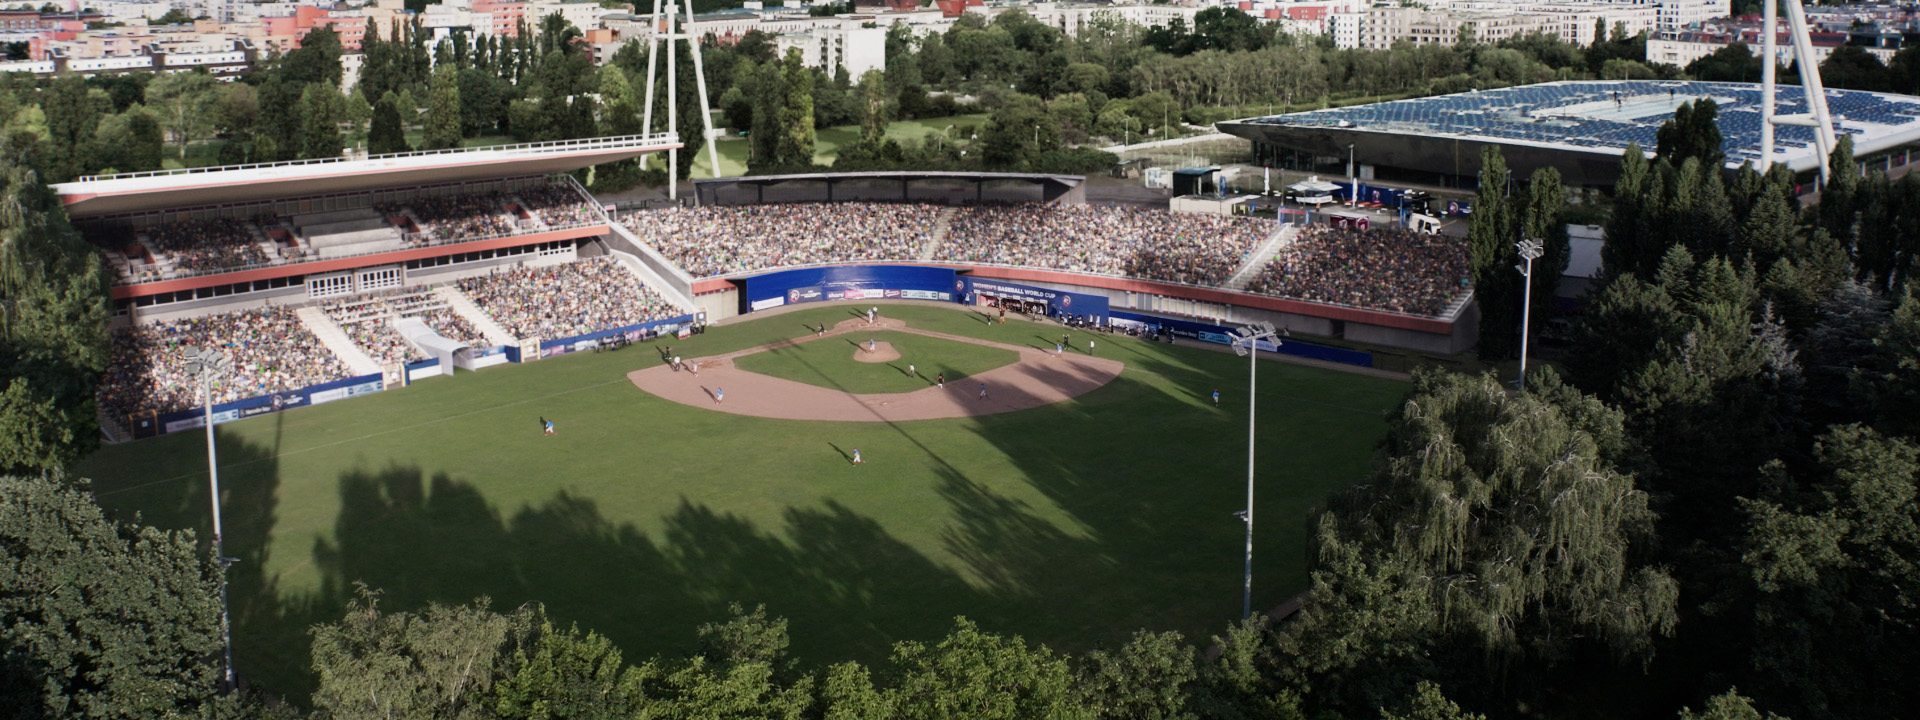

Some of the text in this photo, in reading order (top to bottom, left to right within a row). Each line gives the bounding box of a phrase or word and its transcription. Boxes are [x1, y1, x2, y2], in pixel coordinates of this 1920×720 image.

[973, 282, 997, 290] WOMEN'S
[997, 285, 1024, 294] BASEBALL
[1024, 289, 1044, 297] WORLD
